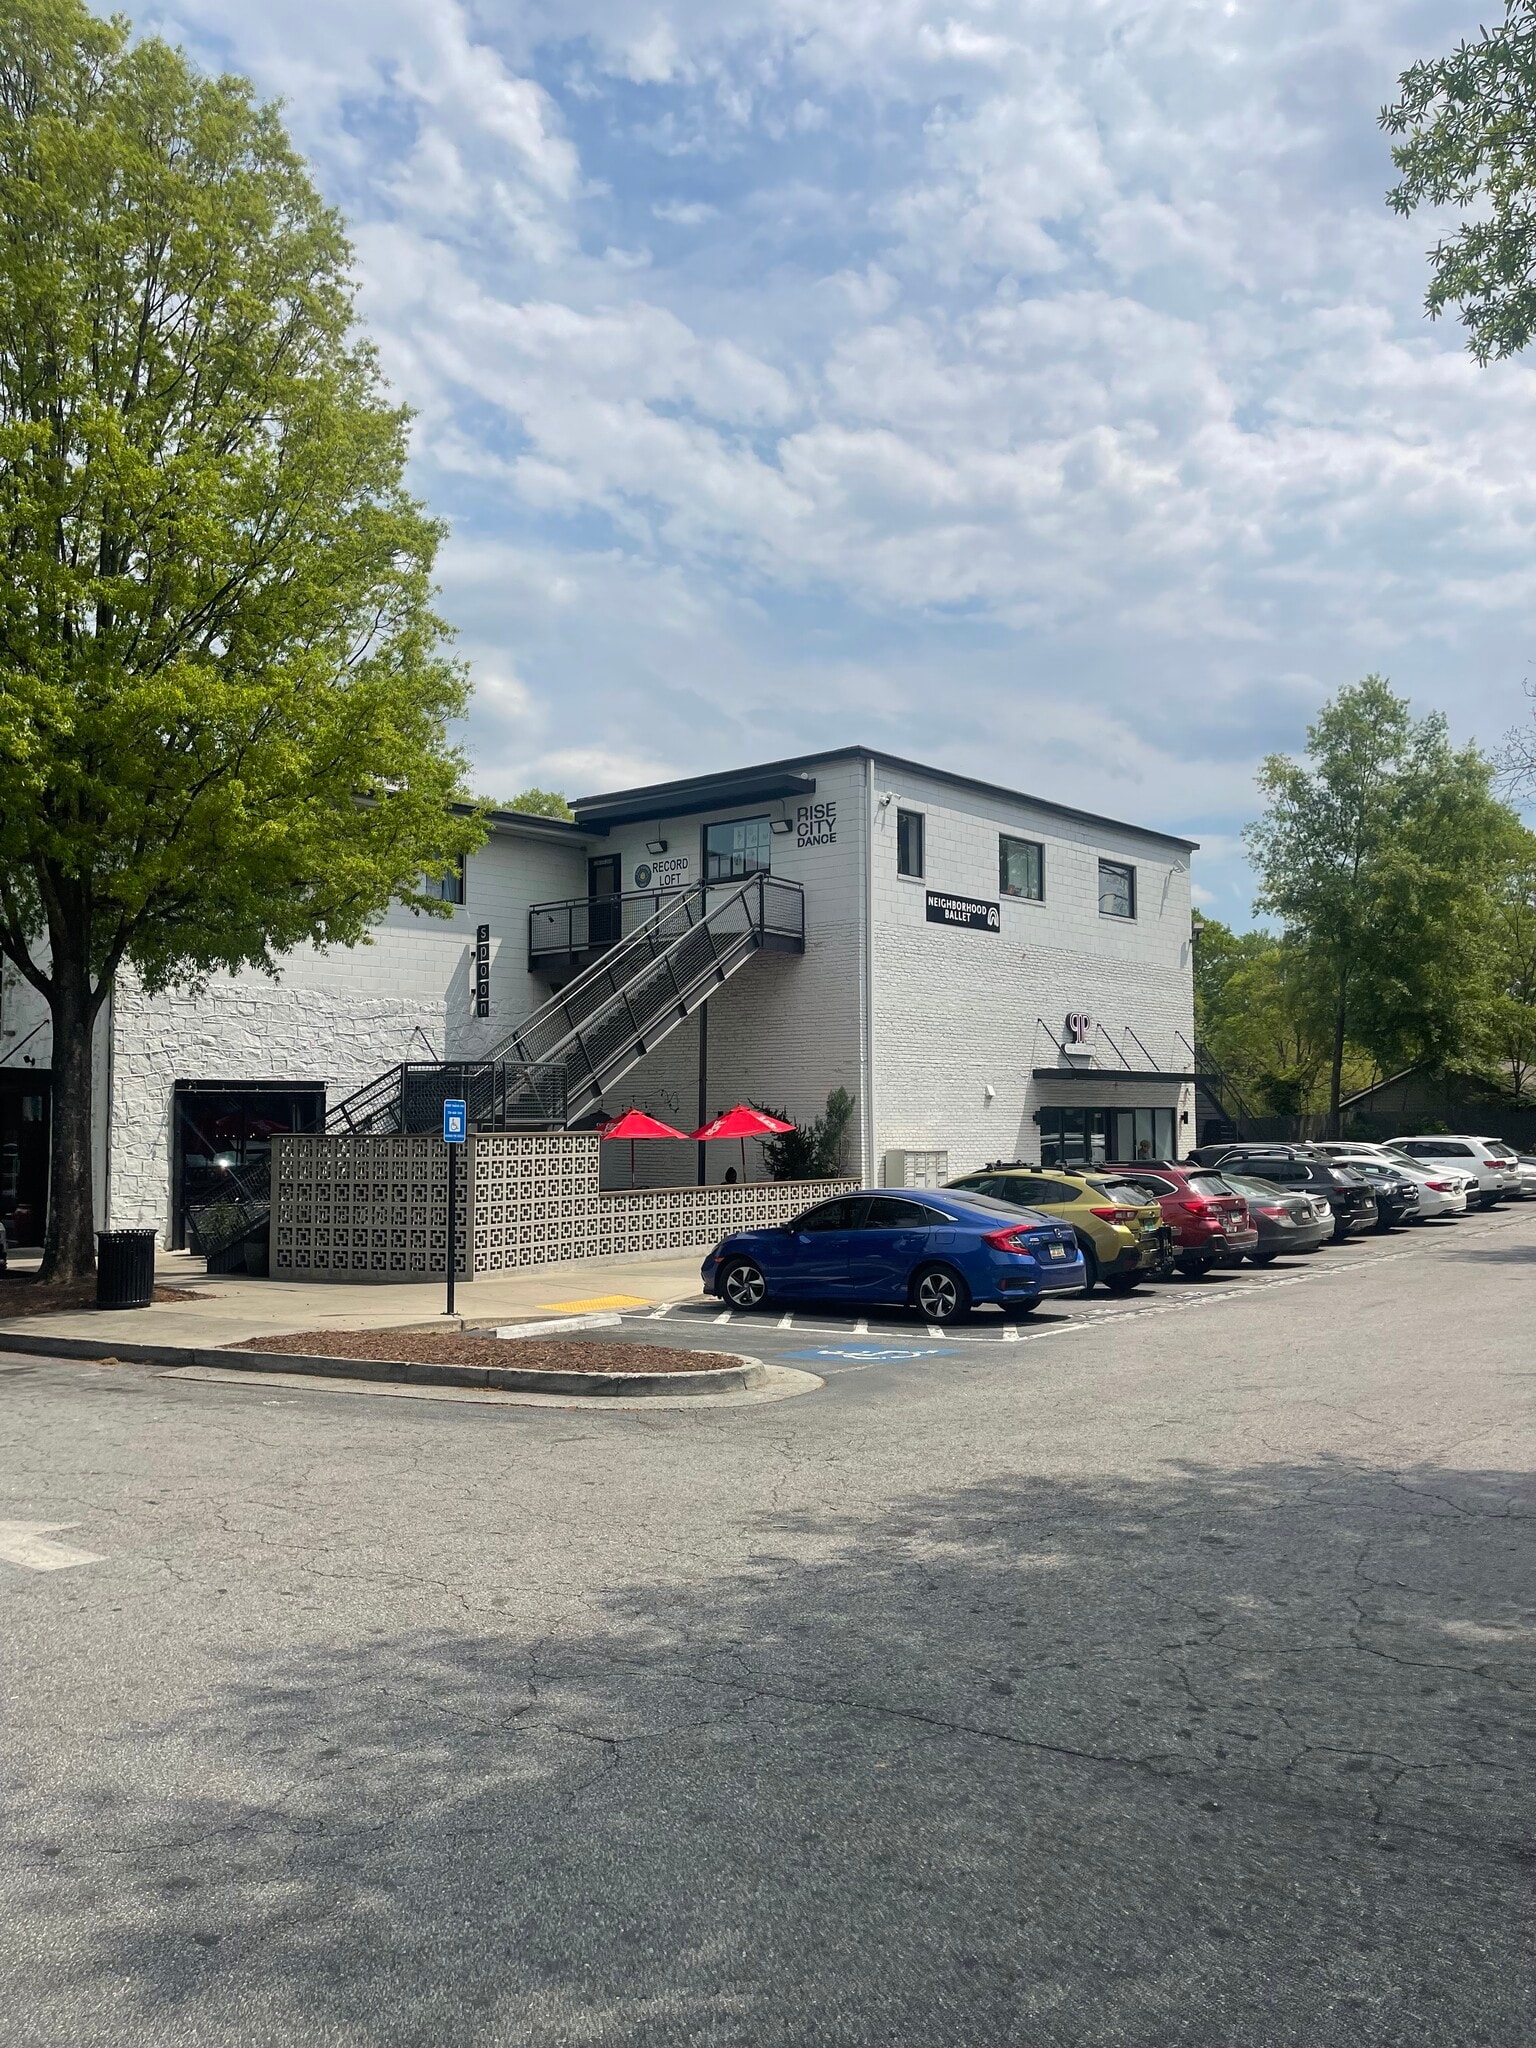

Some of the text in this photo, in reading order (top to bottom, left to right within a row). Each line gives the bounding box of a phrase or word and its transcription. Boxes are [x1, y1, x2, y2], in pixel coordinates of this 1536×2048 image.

[797, 802, 837, 822] RISE
[797, 818, 837, 837] CITY
[797, 832, 837, 848] DANCE
[652, 858, 689, 873] RECORD
[659, 873, 681, 886] LOFT
[928, 896, 987, 916] NEIGHBORHOOD
[944, 909, 971, 923] BALLET
